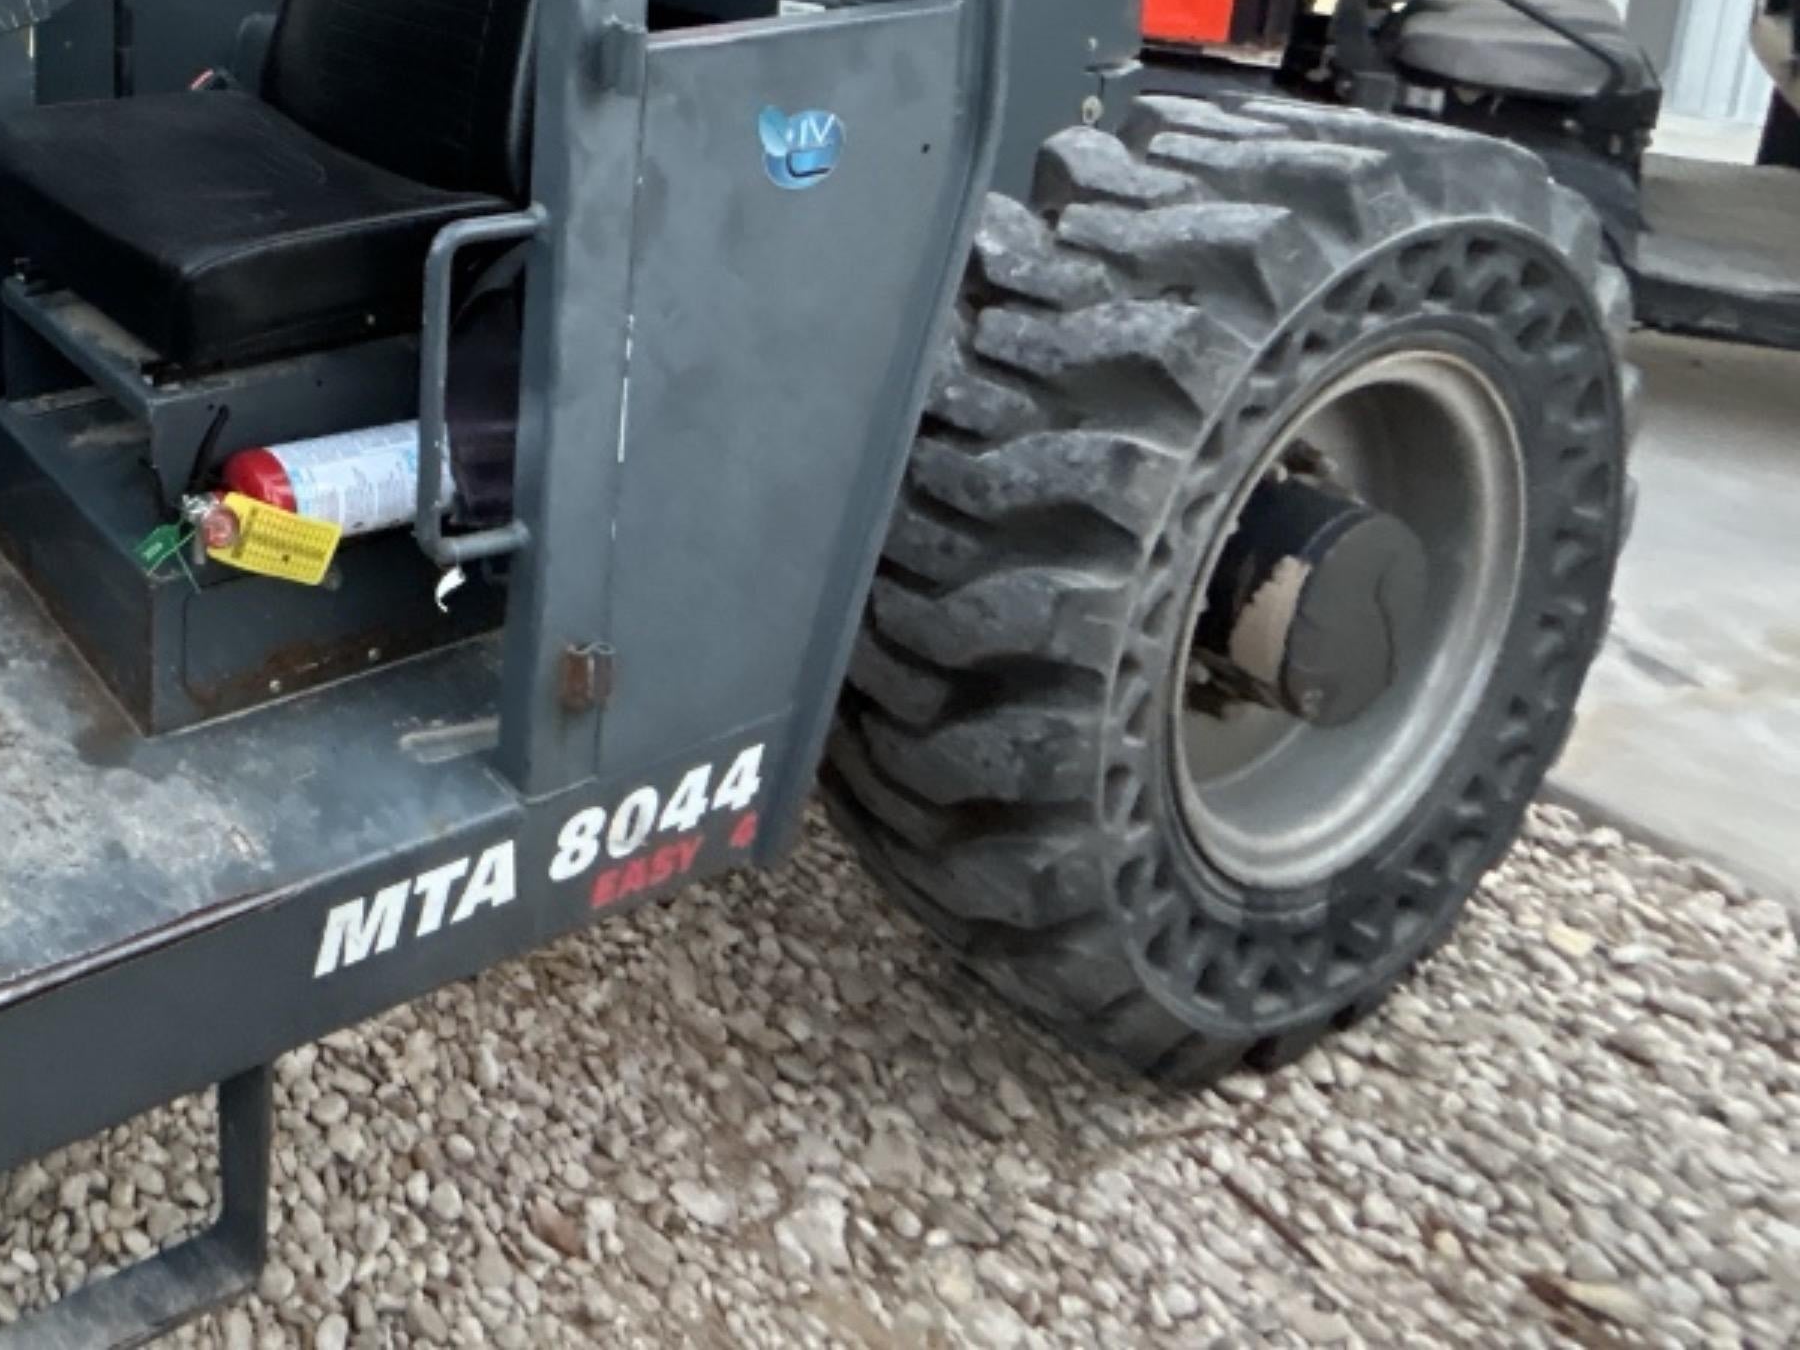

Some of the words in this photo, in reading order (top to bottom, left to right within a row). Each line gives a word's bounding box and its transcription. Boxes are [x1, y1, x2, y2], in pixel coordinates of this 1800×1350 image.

[313, 840, 516, 978] MTA
[549, 744, 765, 881] 8044
[591, 836, 704, 908] EASY
